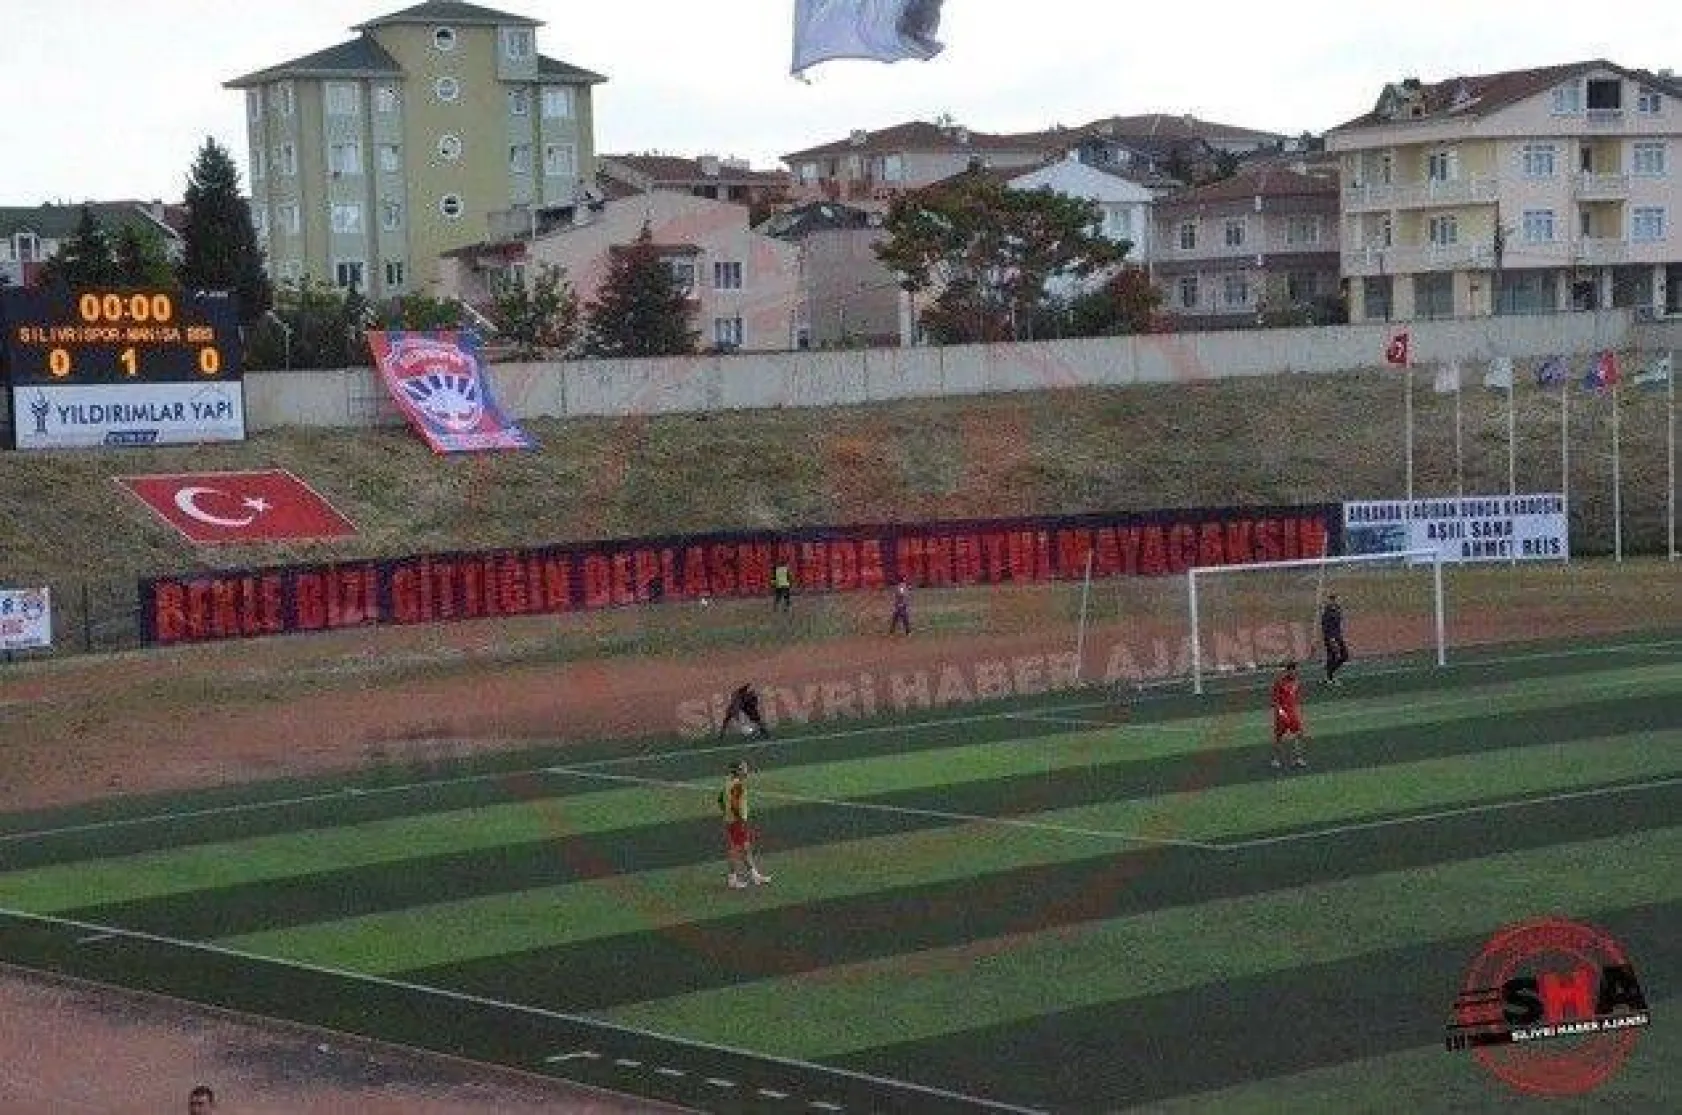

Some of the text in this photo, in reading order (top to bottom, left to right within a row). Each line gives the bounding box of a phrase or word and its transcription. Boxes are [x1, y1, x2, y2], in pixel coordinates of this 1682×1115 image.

[80, 294, 171, 321] 00:00
[50, 348, 221, 377] 0 1 0
[57, 401, 233, 425] YILDIRIMLAR YAPI
